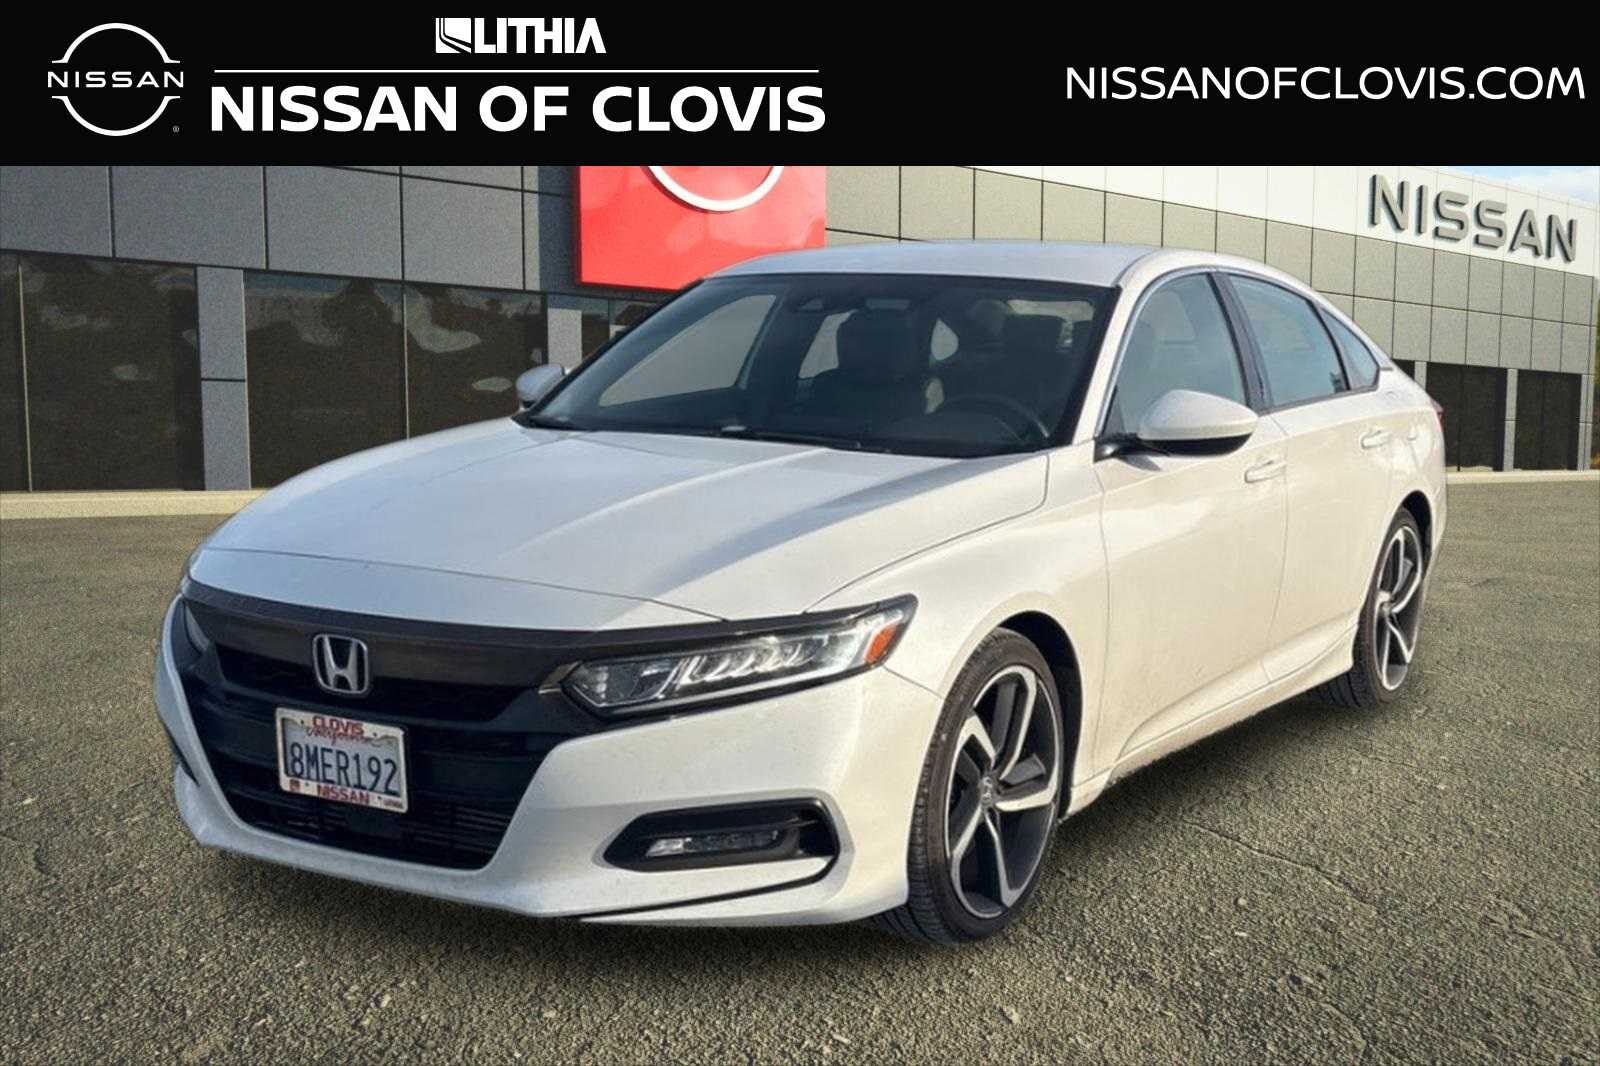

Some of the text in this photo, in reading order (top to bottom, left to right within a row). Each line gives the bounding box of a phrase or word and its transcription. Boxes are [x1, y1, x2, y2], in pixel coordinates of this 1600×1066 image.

[1369, 173, 1577, 263] NISSAN
[312, 715, 365, 736] CLOVIS
[289, 742, 401, 798] 8MER192
[317, 783, 370, 805] NISSAN
